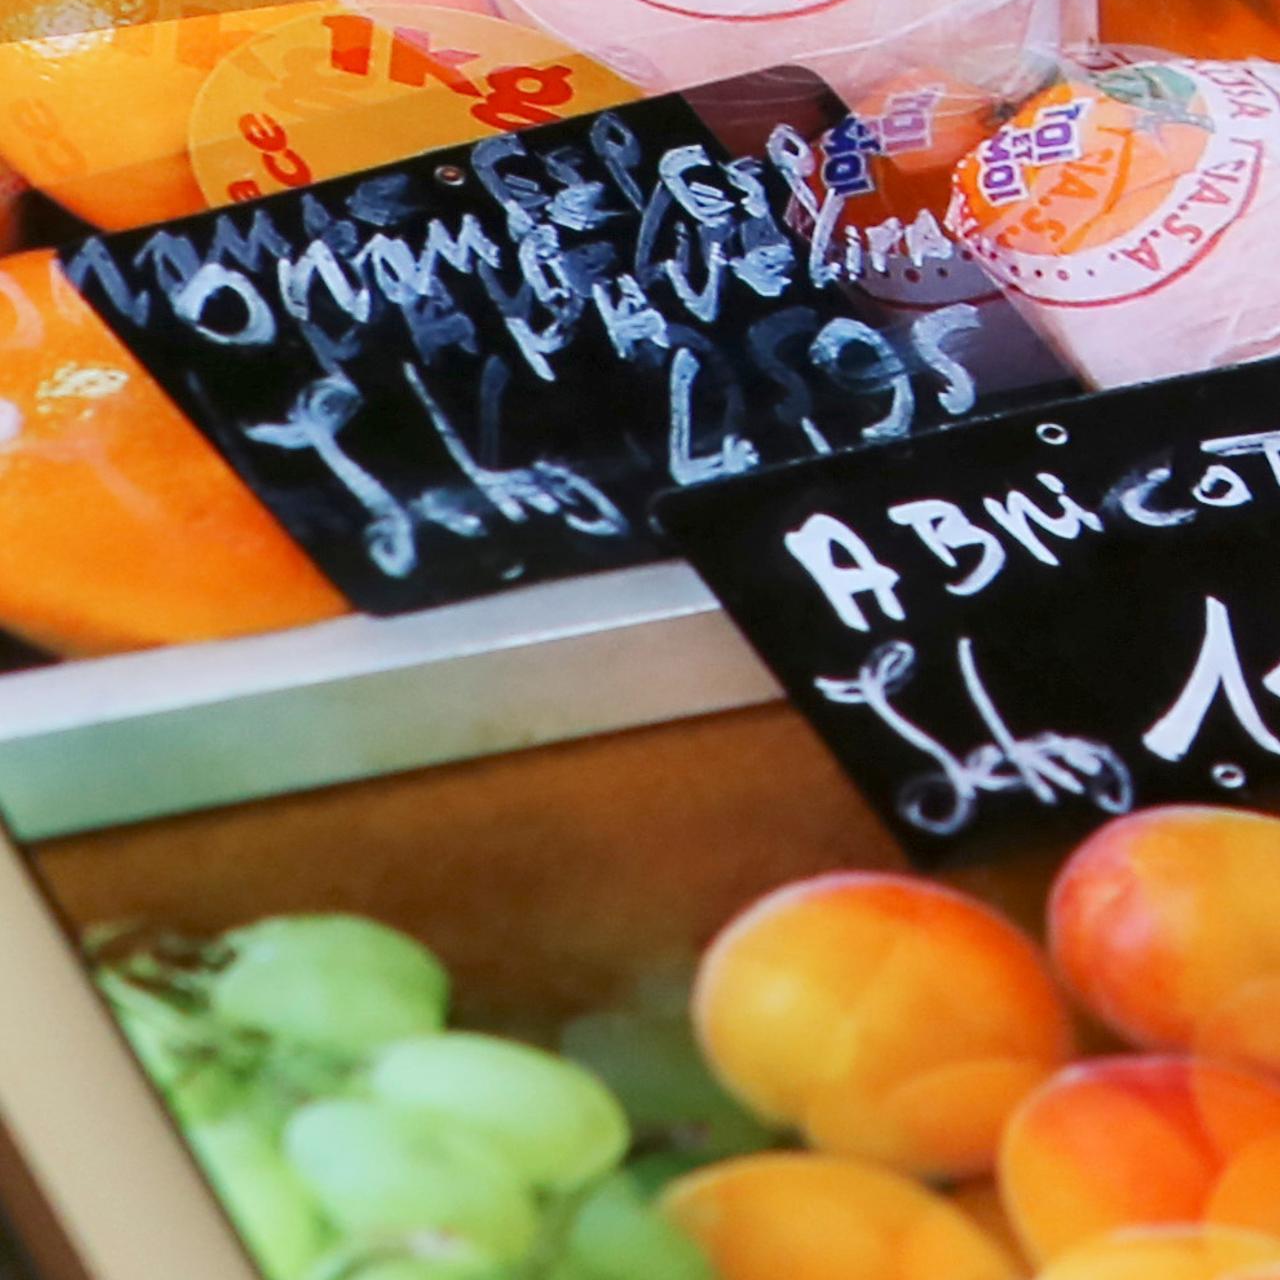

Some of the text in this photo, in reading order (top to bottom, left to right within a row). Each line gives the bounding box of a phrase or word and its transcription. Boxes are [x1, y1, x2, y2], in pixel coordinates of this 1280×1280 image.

[1012, 133, 1033, 160] ET
[1036, 104, 1080, 162] TOI
[982, 130, 1022, 202] MOI
